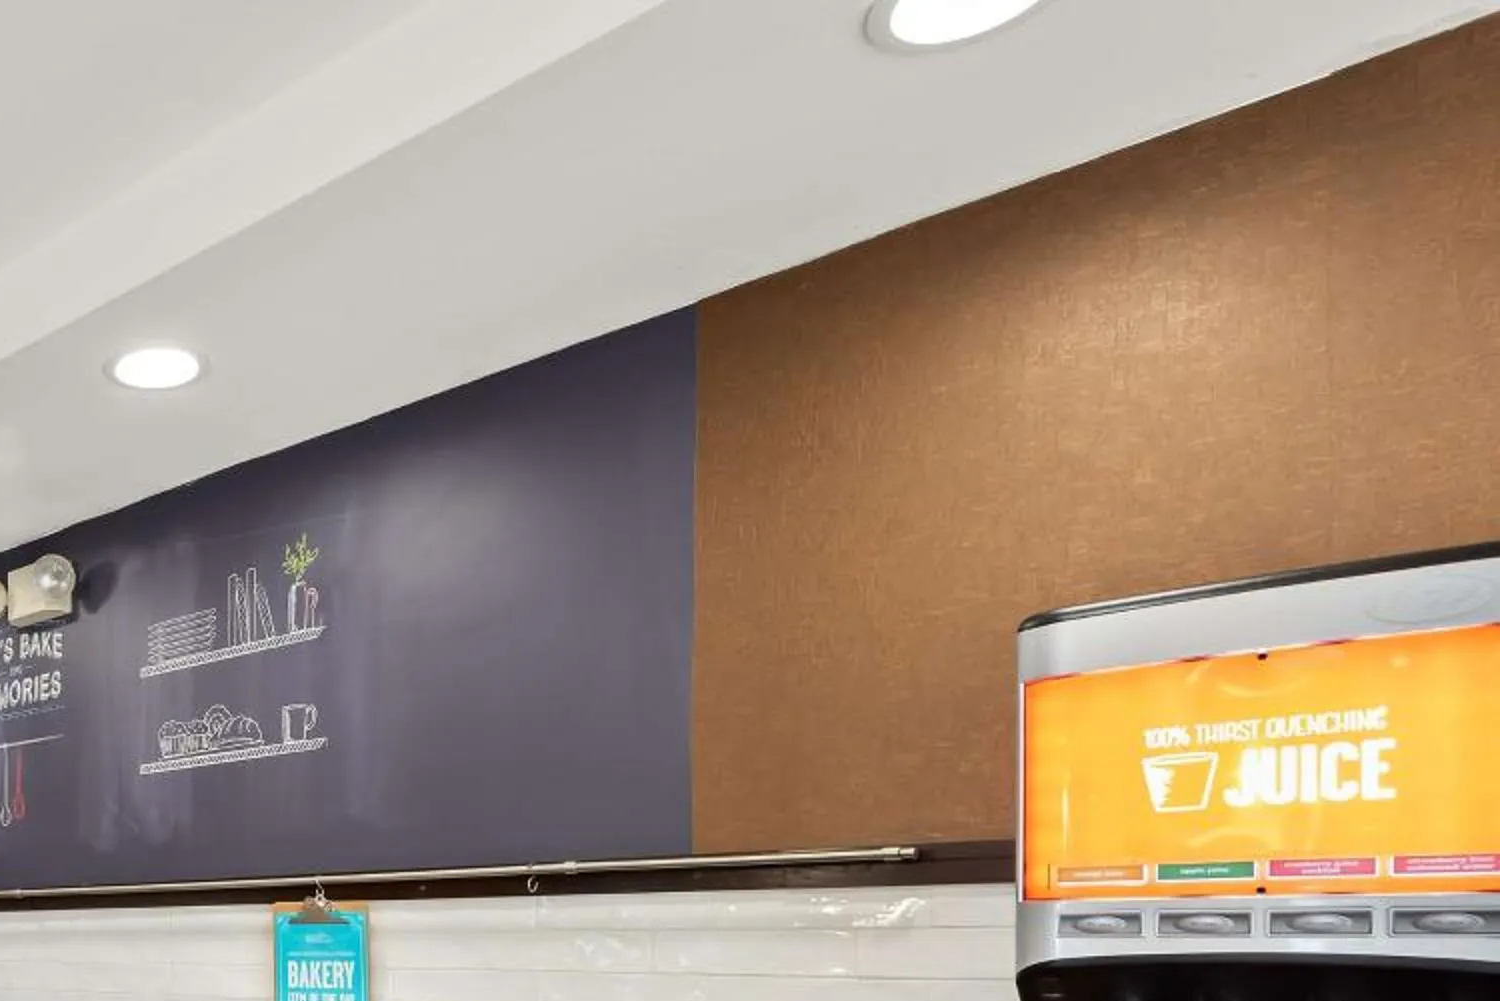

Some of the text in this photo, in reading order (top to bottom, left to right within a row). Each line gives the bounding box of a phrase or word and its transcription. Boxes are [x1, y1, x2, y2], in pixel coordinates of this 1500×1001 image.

[19, 630, 63, 659] BAKE
[1143, 704, 1389, 749] 100% THIRST QUENCHING
[1222, 737, 1398, 808] JUICE
[287, 959, 355, 989] BAKERY
